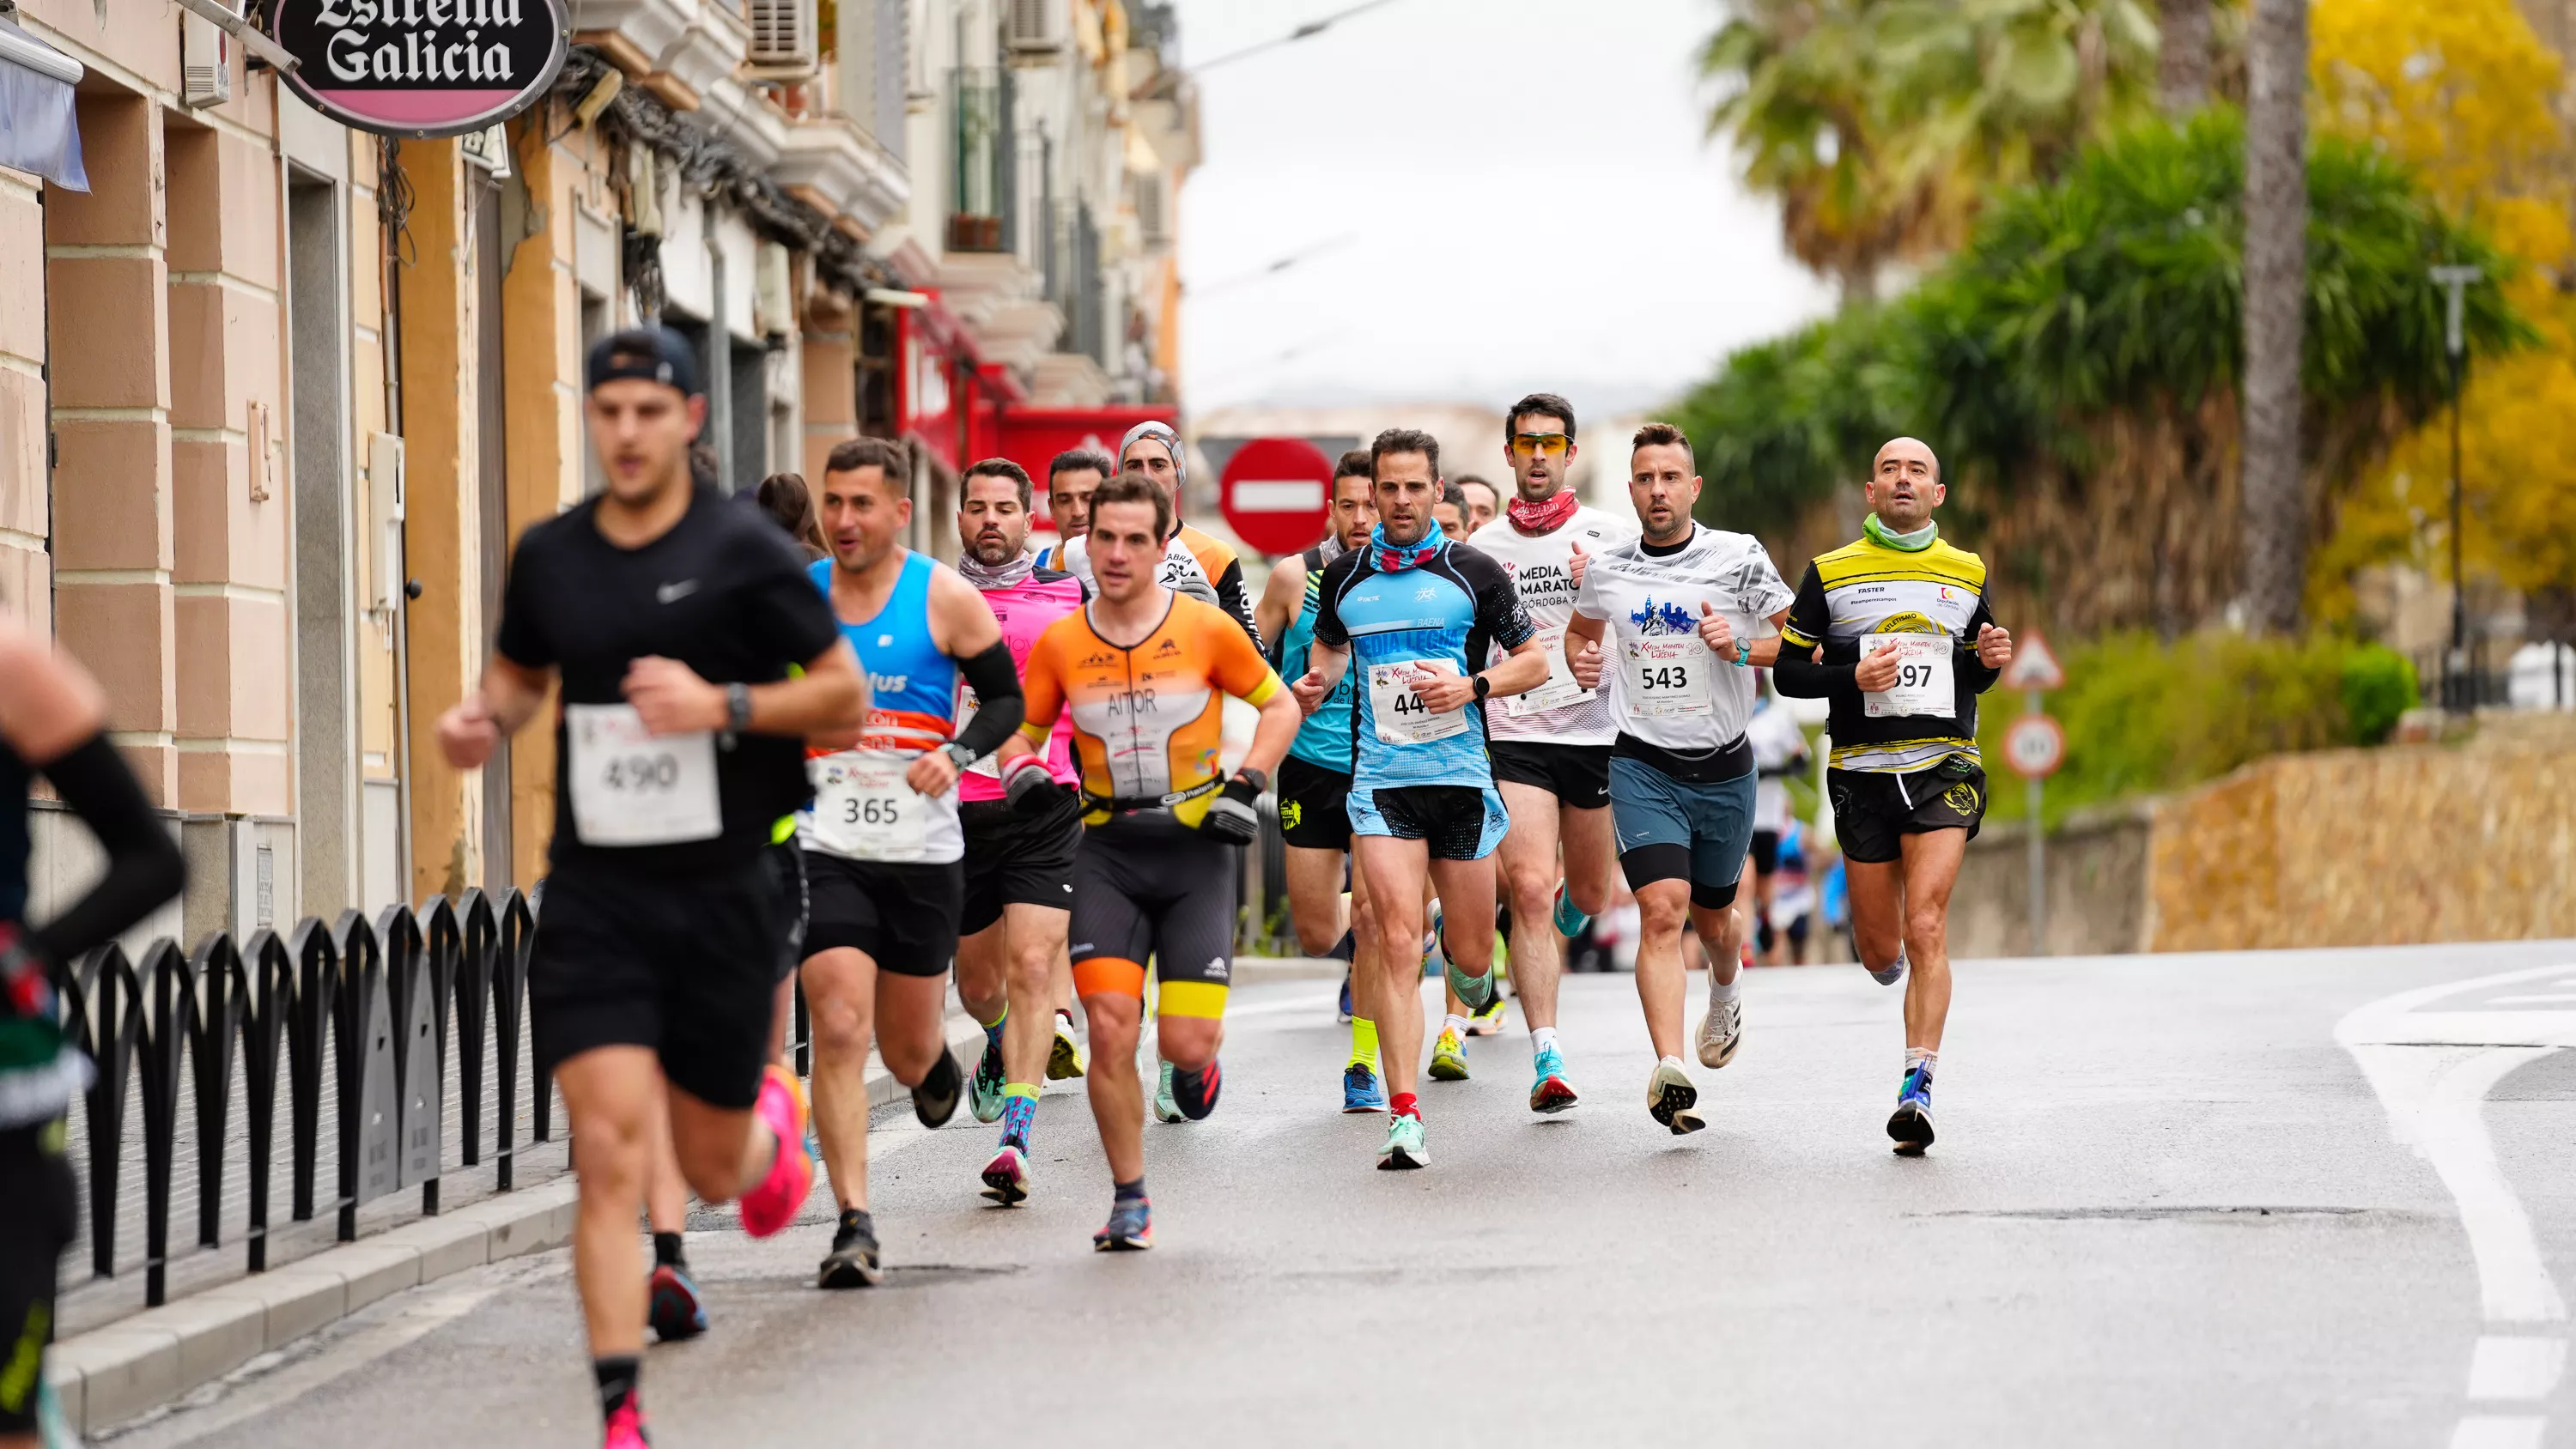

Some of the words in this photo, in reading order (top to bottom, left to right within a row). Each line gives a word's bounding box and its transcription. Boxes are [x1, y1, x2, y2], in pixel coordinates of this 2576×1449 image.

[326, 28, 514, 82] Galicia
[1167, 553, 1193, 566] ABRA
[1519, 566, 1563, 581] MEDIA
[1520, 579, 1581, 596] MARATO
[1417, 618, 1444, 627] BAENA
[1884, 613, 1917, 633] ATLETISMO
[1651, 651, 1679, 659] LUCENA
[1642, 666, 1687, 689] 543
[1109, 688, 1157, 717] AITOR
[1394, 692, 1425, 716] 44
[601, 754, 680, 794] 490
[845, 798, 898, 824] 365
